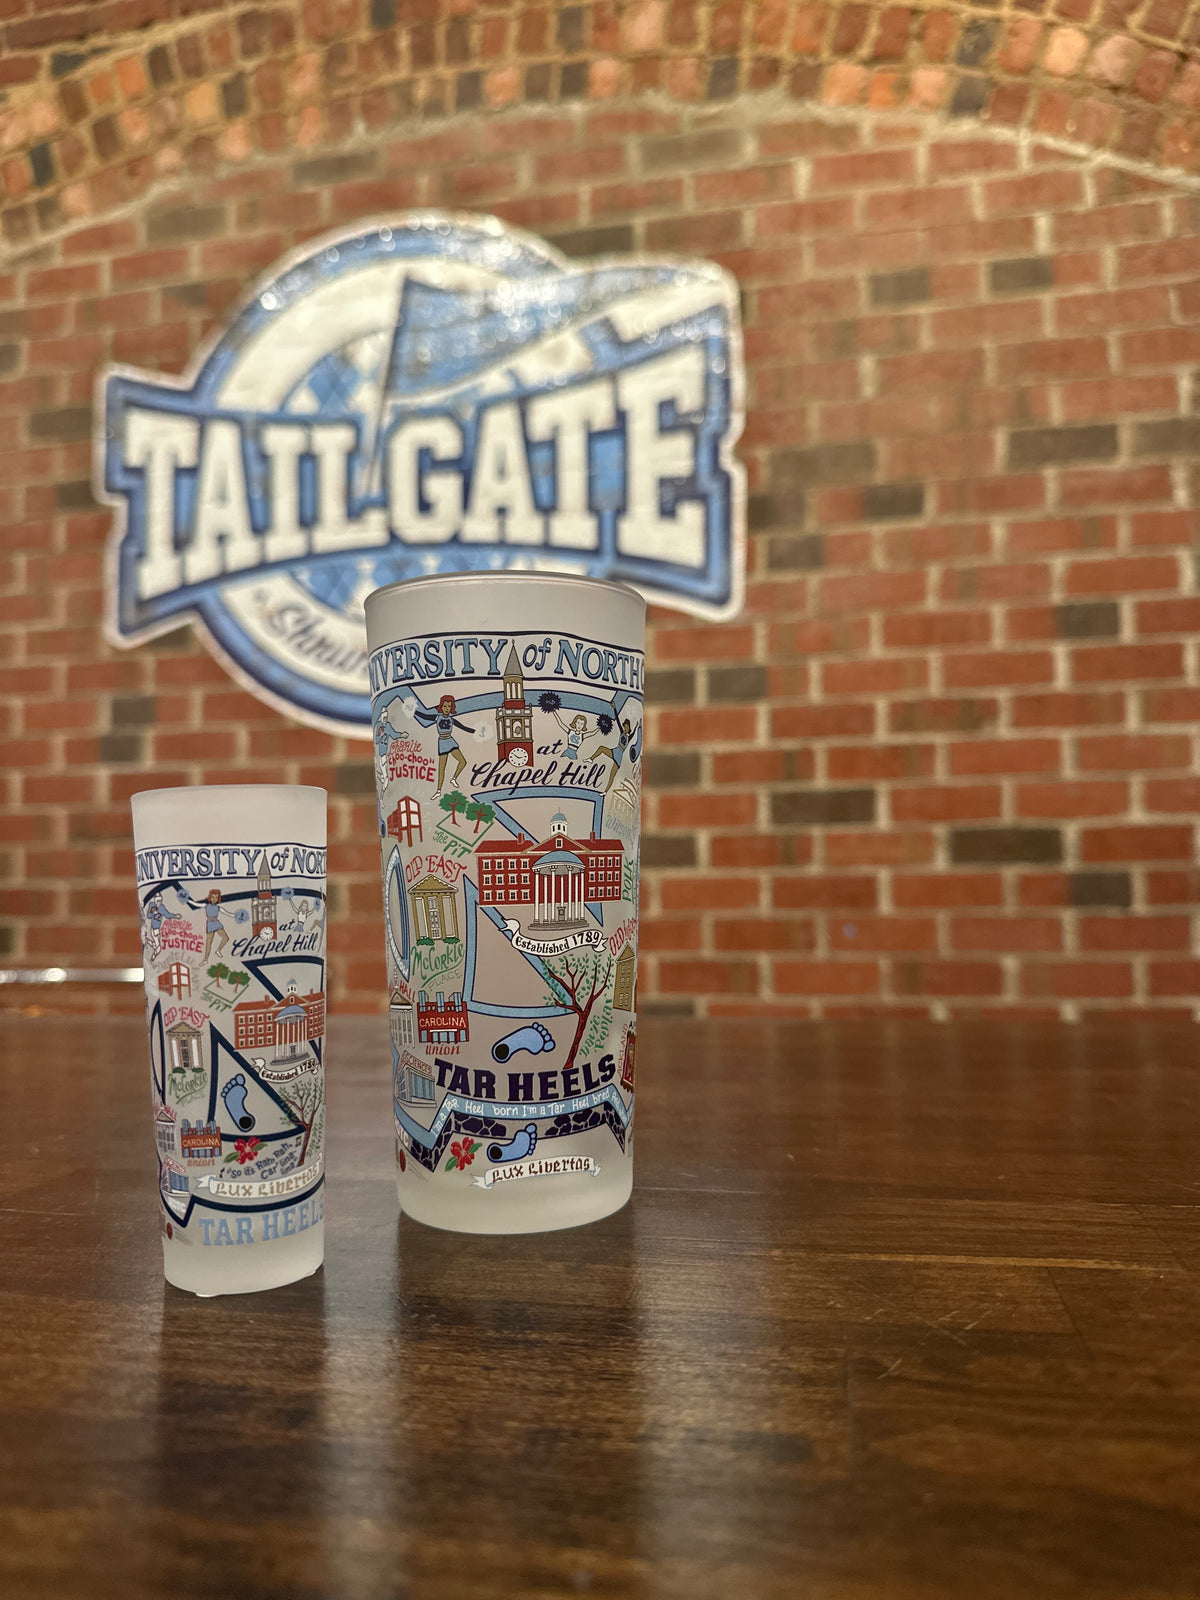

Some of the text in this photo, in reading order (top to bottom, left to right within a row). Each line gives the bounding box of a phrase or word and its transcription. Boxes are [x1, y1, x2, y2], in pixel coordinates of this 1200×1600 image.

[122, 342, 707, 600] TAILGATE
[522, 637, 553, 671] of
[554, 639, 641, 690] NORTH
[536, 738, 563, 756] at
[389, 763, 437, 783] JUSTICE
[470, 758, 558, 796] Chapel
[558, 761, 607, 789] Hill
[270, 847, 290, 872] of
[405, 854, 468, 883] OLD EAST
[278, 919, 295, 932] at
[161, 937, 205, 953] JUSTICE
[231, 933, 319, 958] Chapel Hill
[515, 931, 600, 954] Established 1789
[179, 1006, 211, 1029] EAST
[419, 1017, 467, 1028] CAROLINA
[425, 1044, 462, 1055] union
[434, 1053, 616, 1102] TAR HEELS
[465, 1100, 484, 1116] Heel
[491, 1104, 519, 1116] born
[539, 1106, 546, 1115] a
[548, 1103, 566, 1115] Tar
[182, 1137, 221, 1147] CAROLINA
[528, 1157, 591, 1176] Libertas
[199, 1216, 255, 1247] TAR
